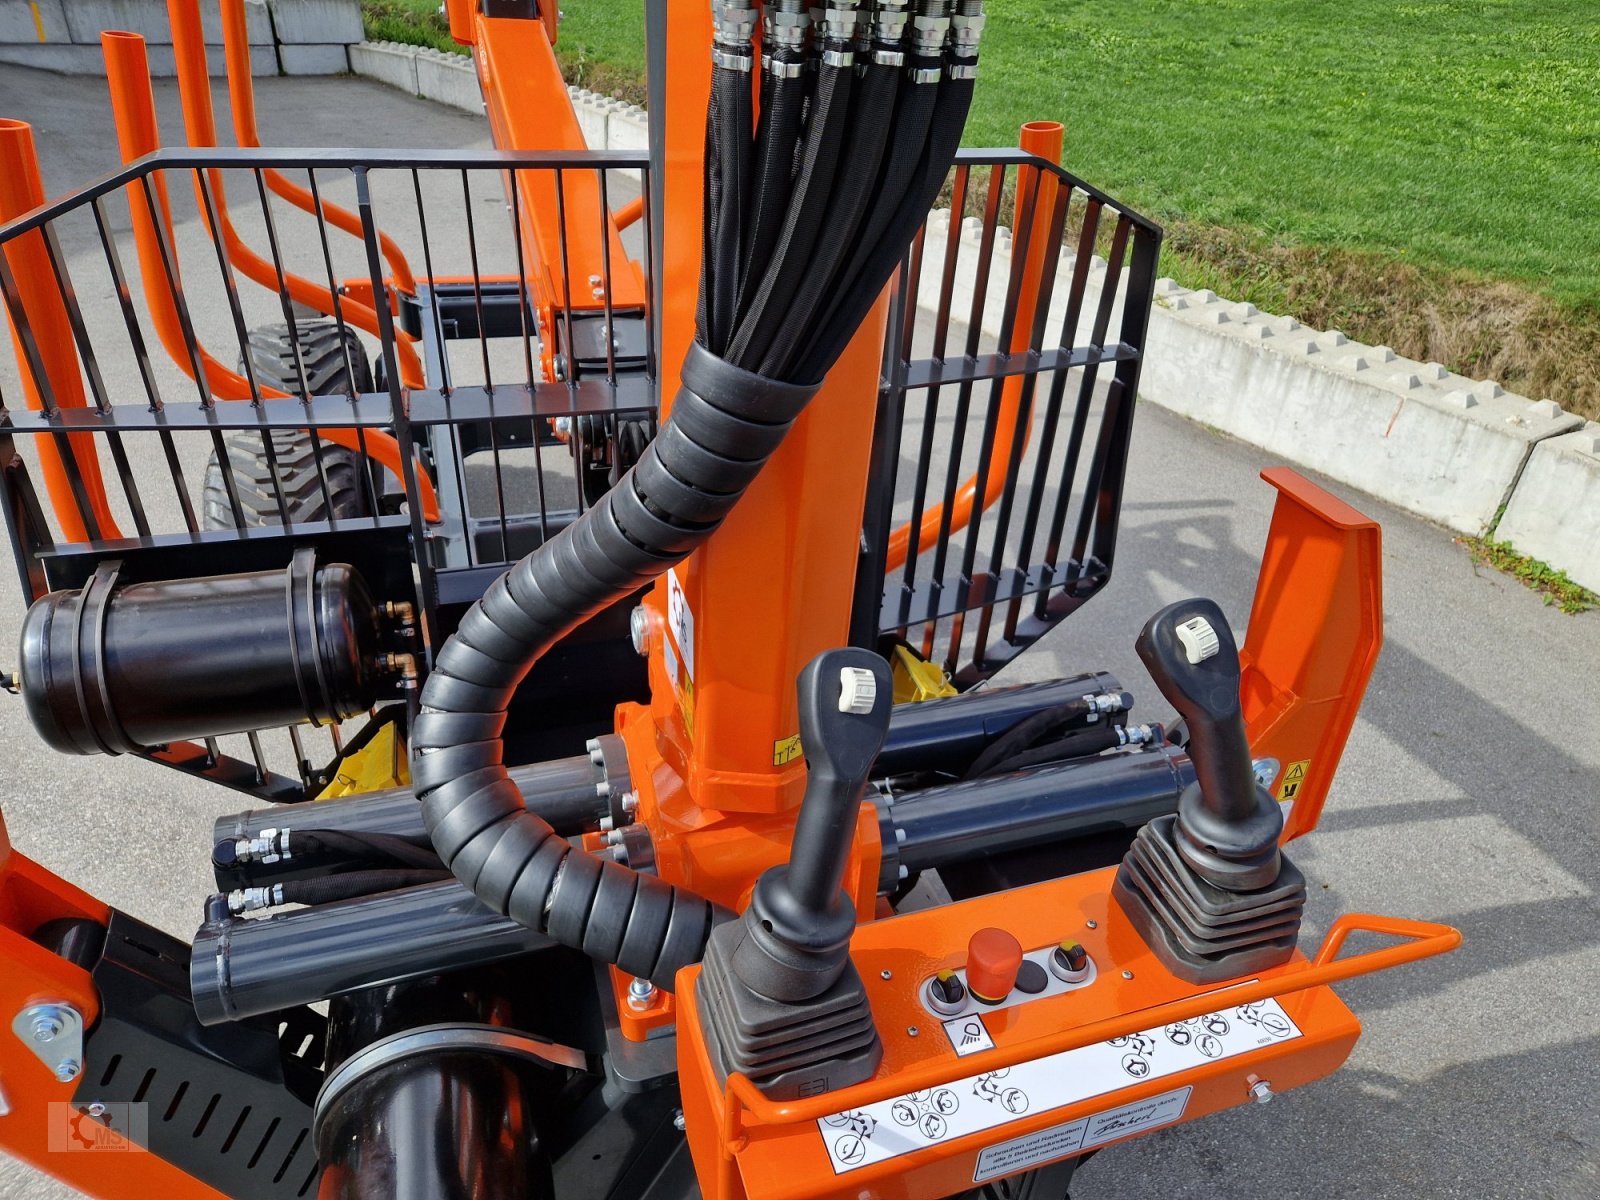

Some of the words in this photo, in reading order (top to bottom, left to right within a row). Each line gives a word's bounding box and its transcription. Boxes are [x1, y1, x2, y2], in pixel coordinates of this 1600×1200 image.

[985, 1144, 1025, 1159] Schrauben
[1026, 1138, 1041, 1147] und
[1025, 1151, 1040, 1161] und
